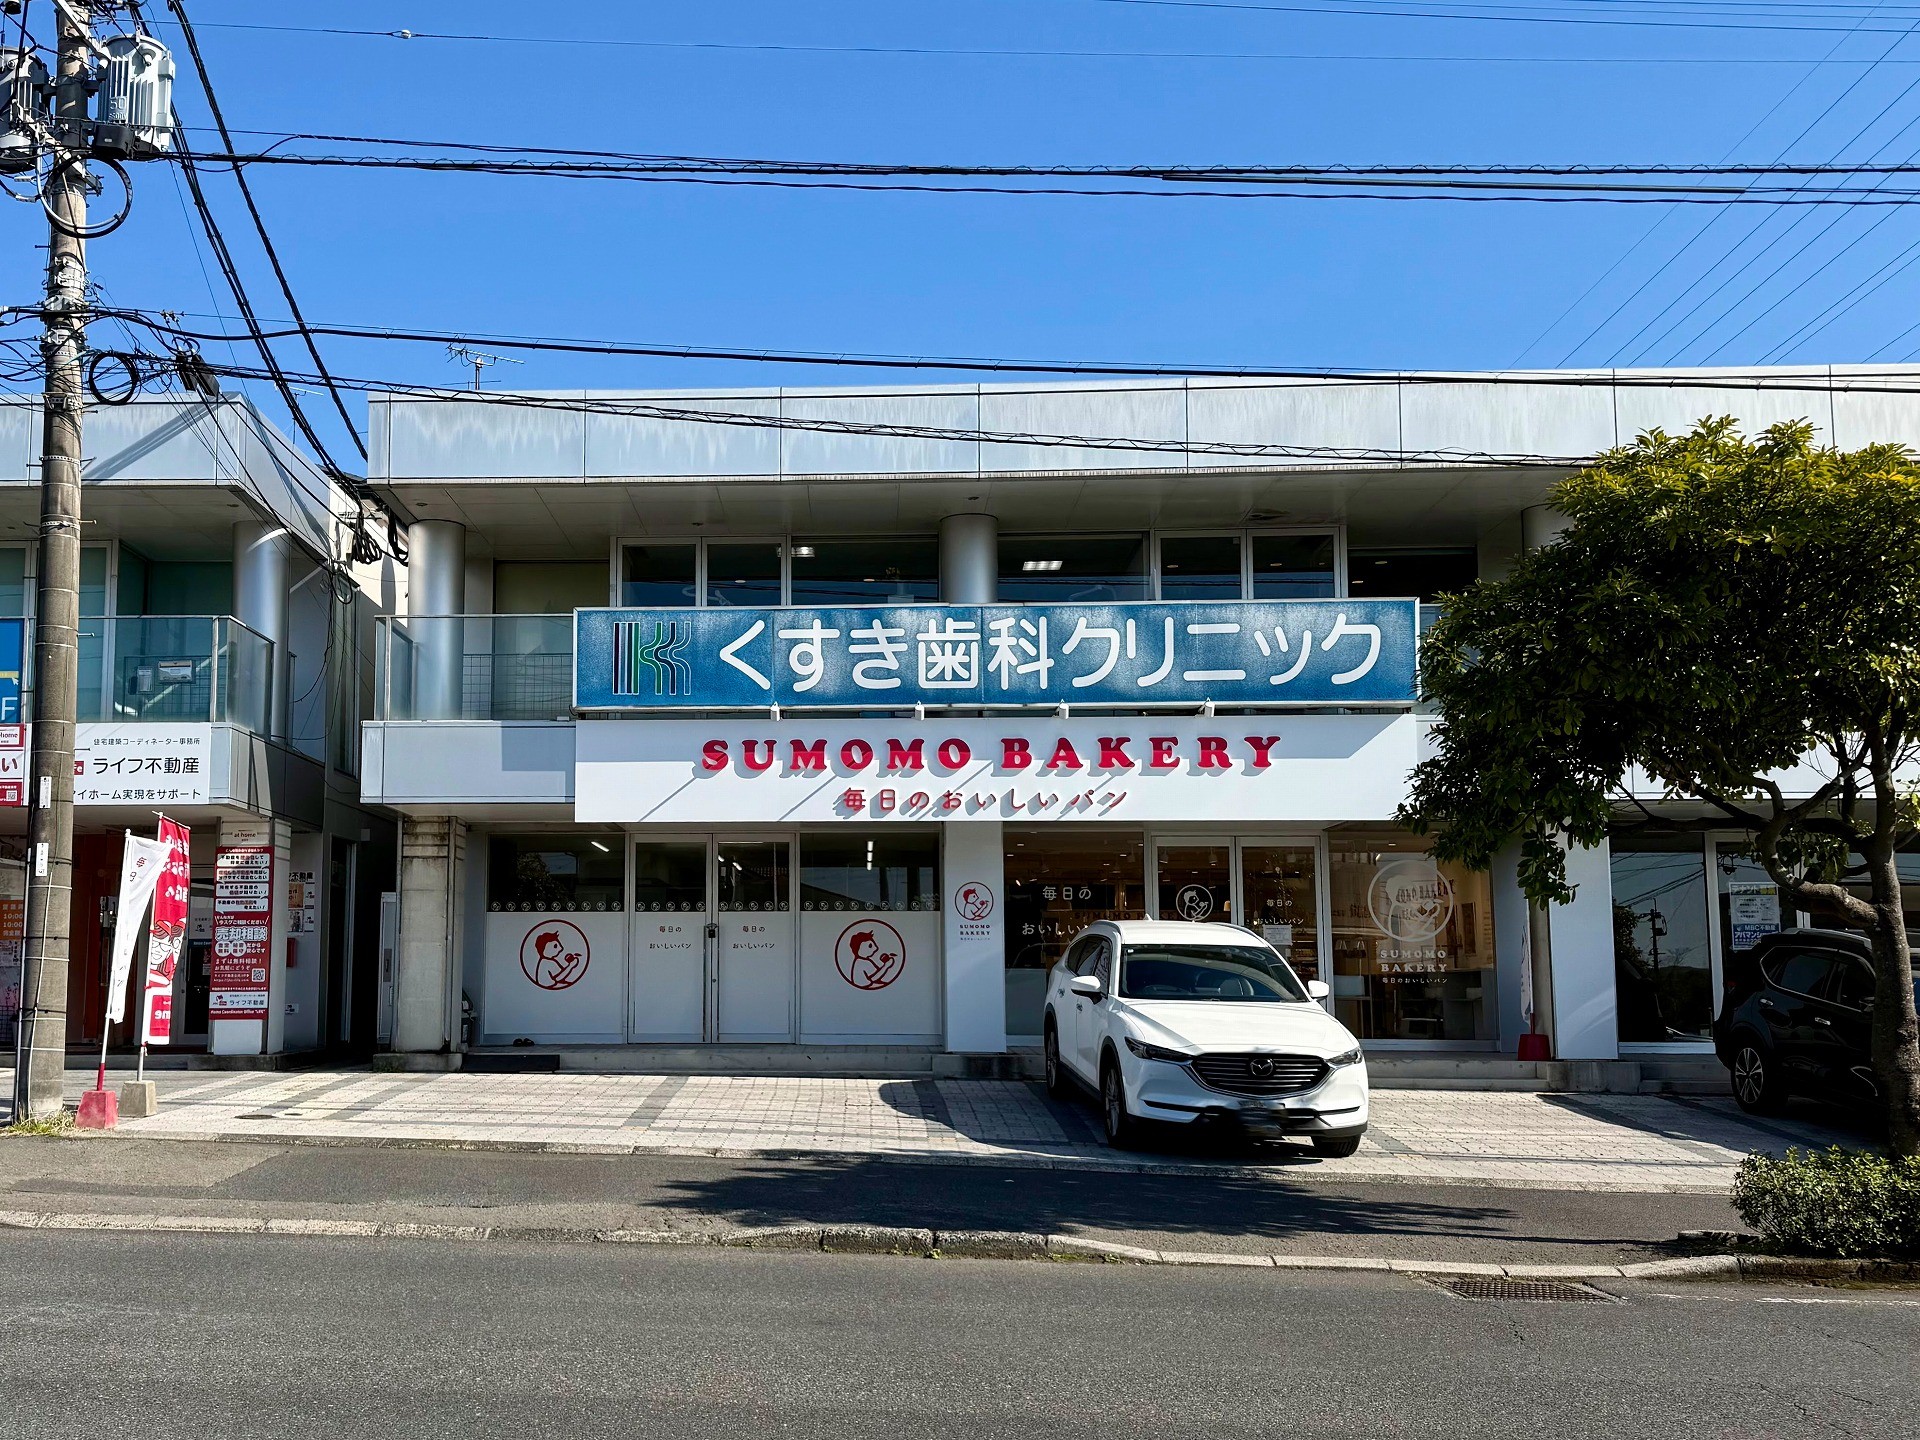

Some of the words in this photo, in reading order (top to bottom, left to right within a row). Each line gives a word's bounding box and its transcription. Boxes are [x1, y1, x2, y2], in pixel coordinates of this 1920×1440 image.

[719, 613, 1382, 692] くすき歯科クリニック
[94, 738, 200, 746] 住宅建築コーディネーター事務所
[702, 738, 971, 771] SUMOMO
[1000, 736, 1281, 769] BAKERY
[93, 757, 199, 774] ライフ不動産
[73, 789, 201, 800] イホーム実現をサポート
[844, 787, 1127, 812] 毎日のおいしいパン
[1042, 885, 1092, 900] 毎日の
[215, 927, 266, 940] 売却相談
[659, 925, 682, 933] 毎日の
[742, 925, 766, 933] 毎日の
[649, 942, 692, 950] おいしいパン
[732, 942, 775, 950] おいしいパン
[1380, 949, 1447, 959] SUMOMO
[1381, 963, 1447, 973] BAKERY
[1382, 976, 1448, 984] 毎日のおいしいパン
